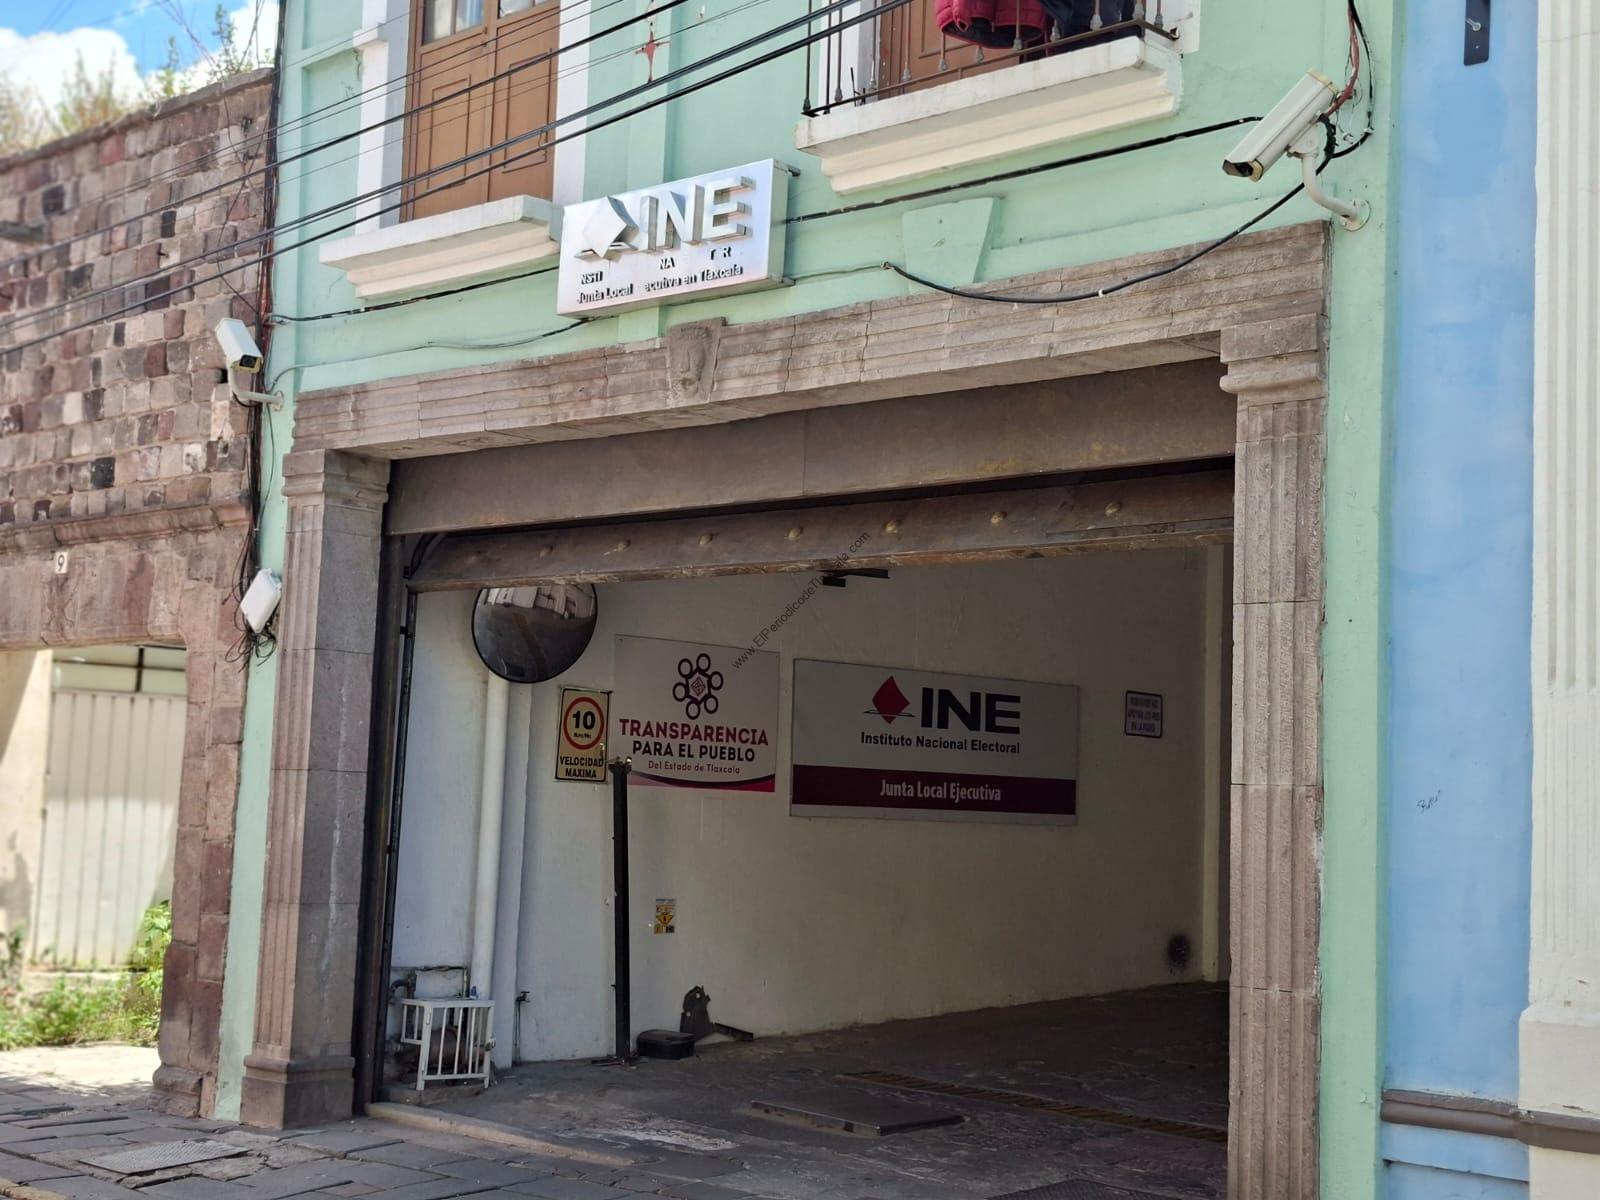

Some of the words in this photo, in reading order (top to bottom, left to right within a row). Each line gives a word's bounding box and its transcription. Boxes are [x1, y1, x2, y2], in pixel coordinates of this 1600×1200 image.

[640, 176, 753, 252] INE
[578, 289, 604, 304] Junta
[606, 283, 634, 299] Local
[684, 273, 698, 285] en
[701, 264, 744, 281] Tlaxcala
[58, 554, 65, 571] 9
[573, 710, 596, 730] 10
[921, 687, 1021, 735] INE
[619, 718, 769, 746] TRANSPARENCIA
[861, 732, 912, 747] Instituto
[916, 736, 967, 750] Nacional
[971, 740, 1020, 753] Electoral
[560, 756, 604, 767] VELOCIDAD
[633, 741, 673, 757] PARA
[678, 743, 694, 758] EL
[700, 745, 755, 762] PUEBLO
[565, 768, 597, 778] MAXIMA
[648, 760, 662, 769] Del
[664, 762, 692, 771] Estado
[694, 763, 704, 772] de
[707, 764, 740, 774] Tlaxcala
[880, 779, 914, 797] Junta
[917, 781, 947, 799] Local
[950, 783, 1002, 803] Ejecutiva
